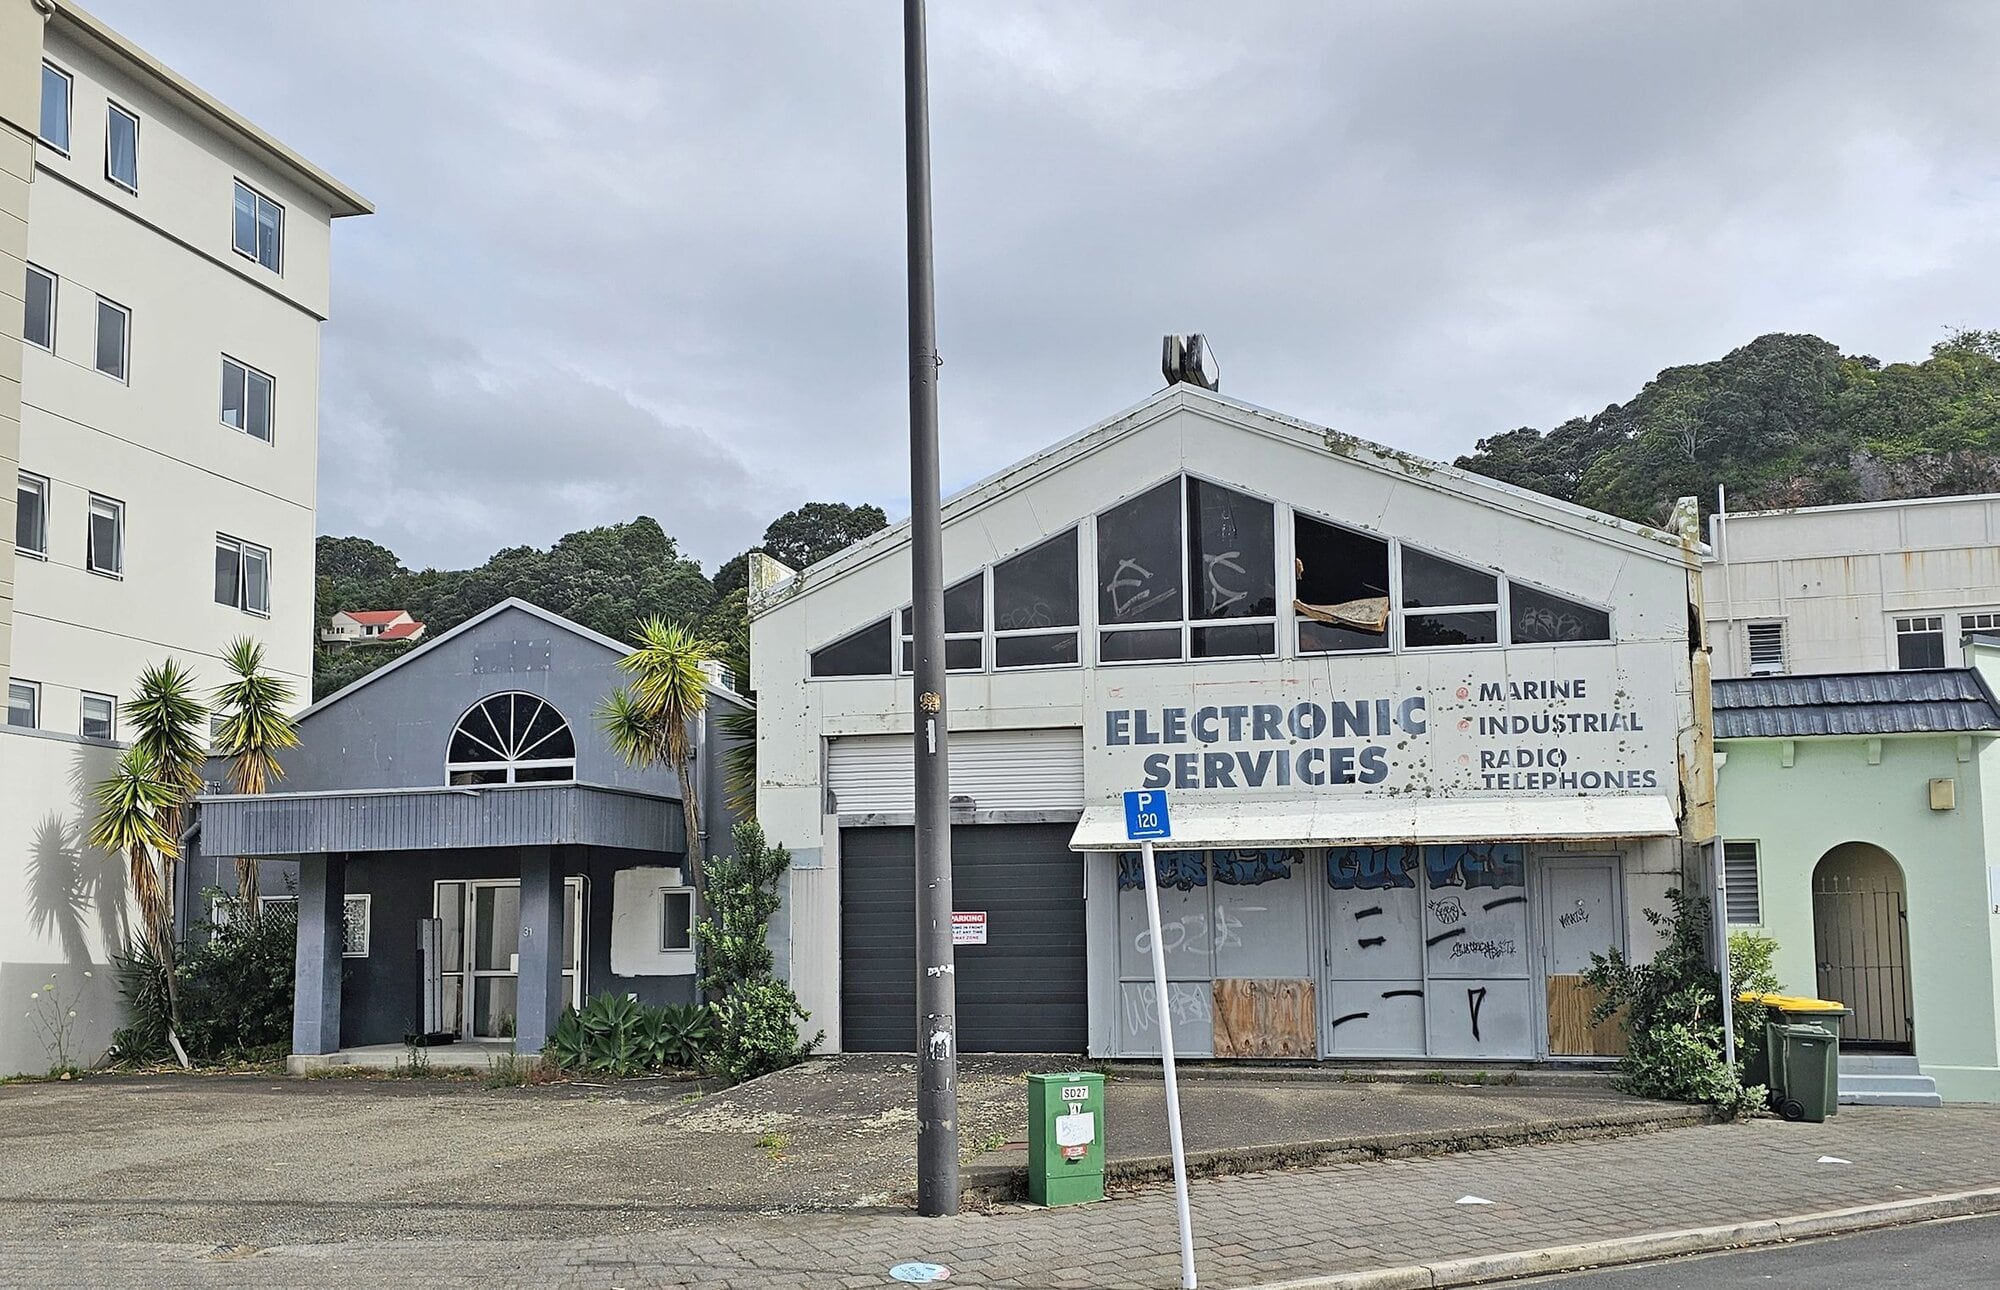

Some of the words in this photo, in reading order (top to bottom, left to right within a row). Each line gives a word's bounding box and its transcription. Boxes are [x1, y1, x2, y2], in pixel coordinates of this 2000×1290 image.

[1479, 679, 1587, 701] MARINE
[1105, 697, 1427, 746] ELECTRONIC
[1479, 712, 1643, 735] INDUSTRIAL
[1142, 745, 1389, 790] SERVICES
[1480, 748, 1568, 769] RADIO
[1481, 770, 1657, 790] TELEPHONES
[1138, 793, 1152, 811] P
[1137, 813, 1158, 828] 120
[523, 926, 532, 937] 31
[1064, 1088, 1086, 1099] SD27
